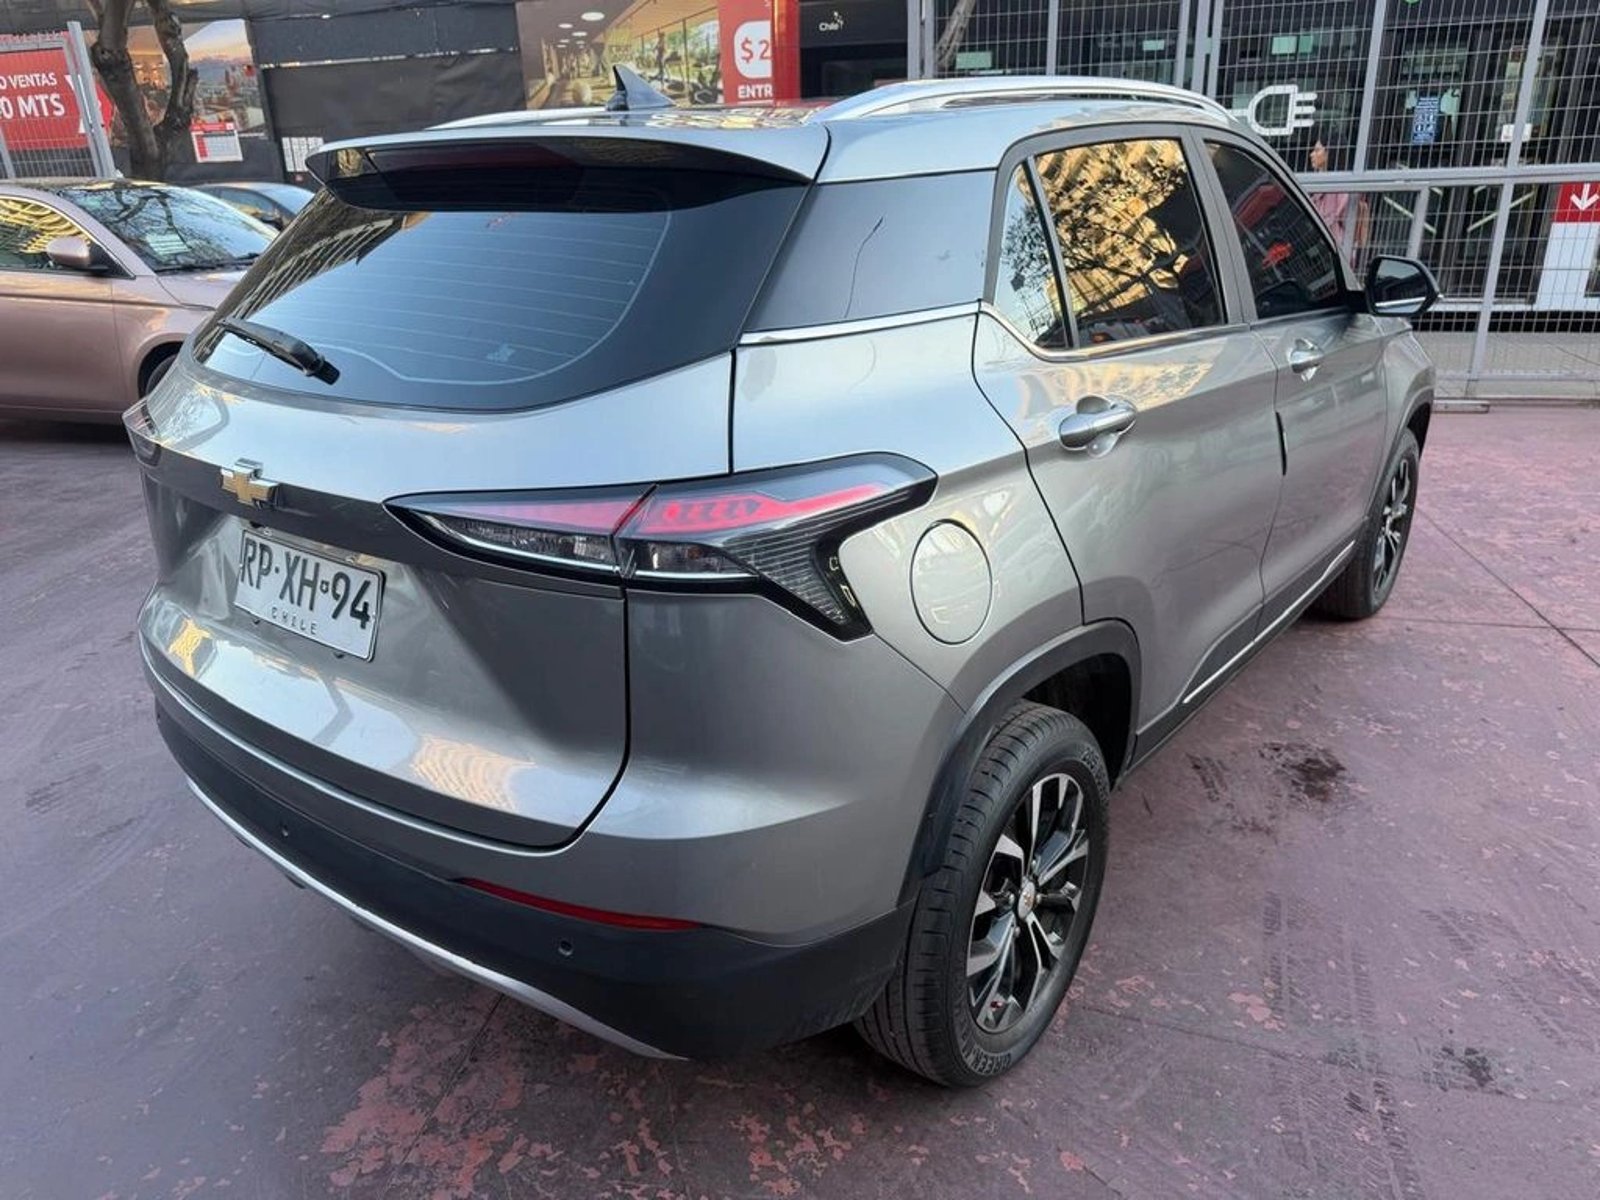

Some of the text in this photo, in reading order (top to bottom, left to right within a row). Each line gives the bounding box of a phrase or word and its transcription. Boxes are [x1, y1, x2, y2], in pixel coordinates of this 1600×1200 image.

[8, 72, 57, 89] VENTAS
[17, 93, 65, 118] MTS
[271, 606, 317, 636] CHILE
